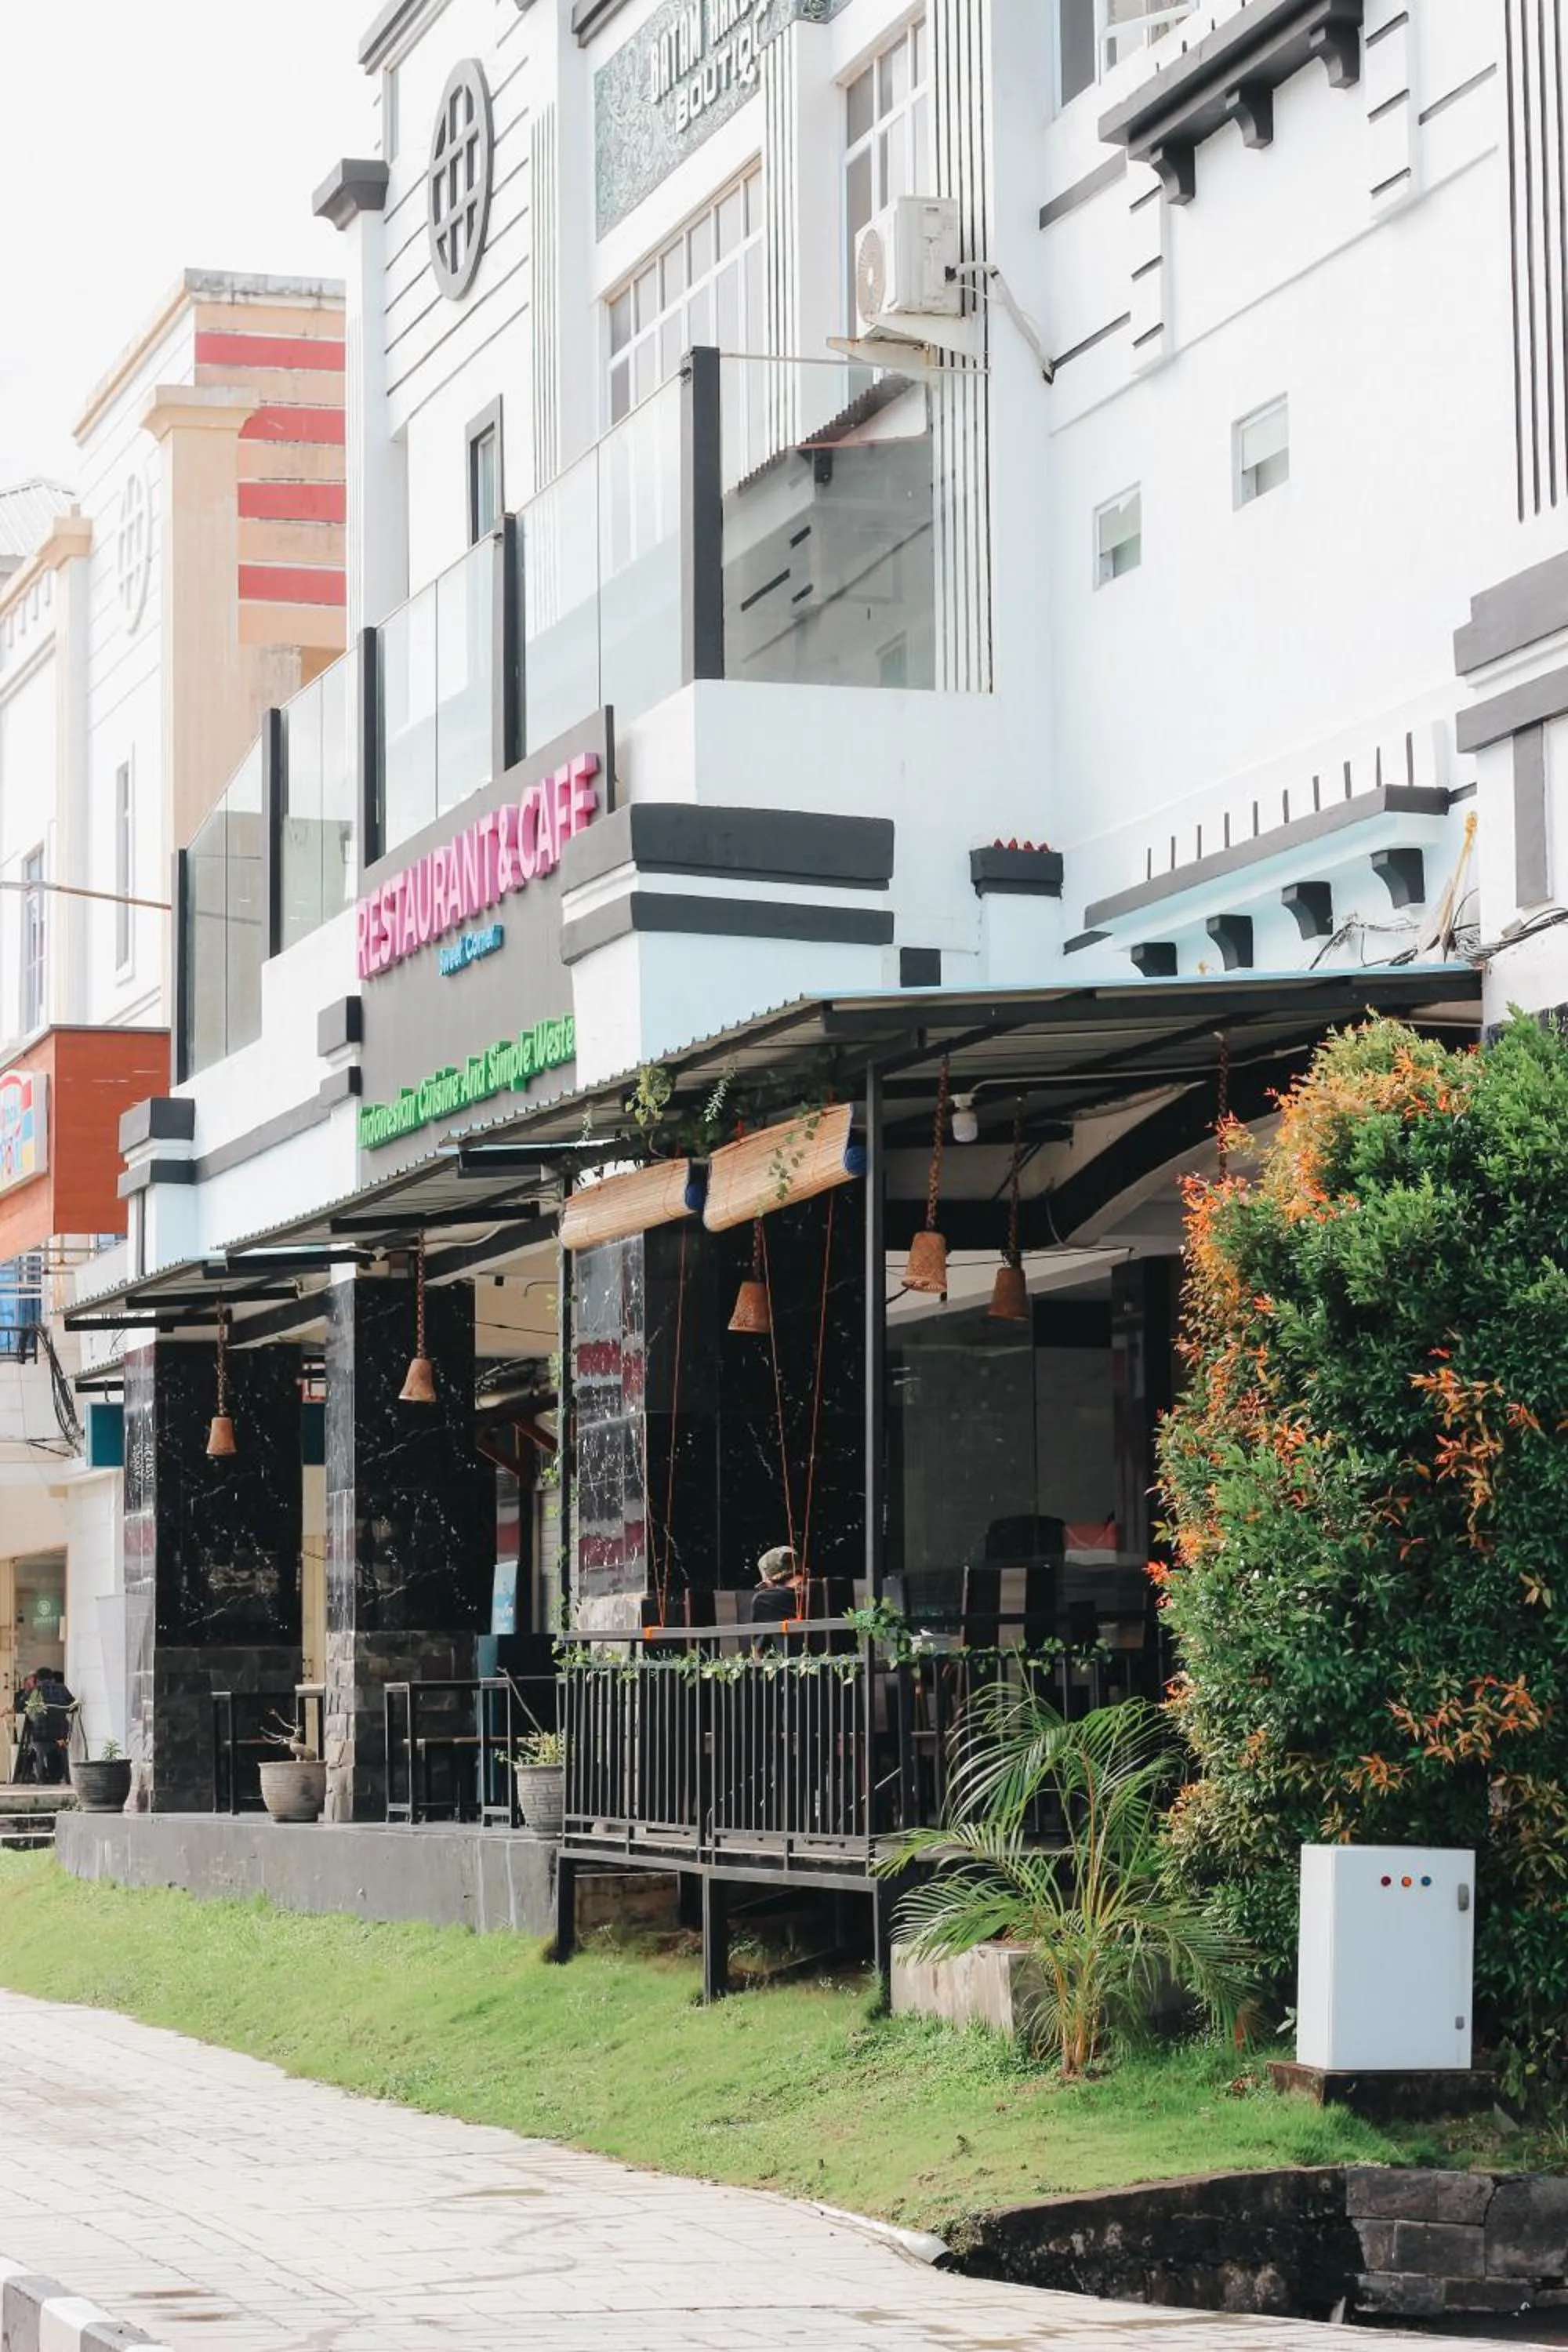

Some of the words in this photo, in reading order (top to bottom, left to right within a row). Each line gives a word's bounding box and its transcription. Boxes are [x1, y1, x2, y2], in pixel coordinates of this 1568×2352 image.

[356, 811, 500, 980] RESTAURANT
[517, 752, 599, 879] CAFE
[417, 1067, 461, 1121] Cuisine
[488, 1029, 535, 1092] Simple
[533, 1013, 576, 1068] Weste
